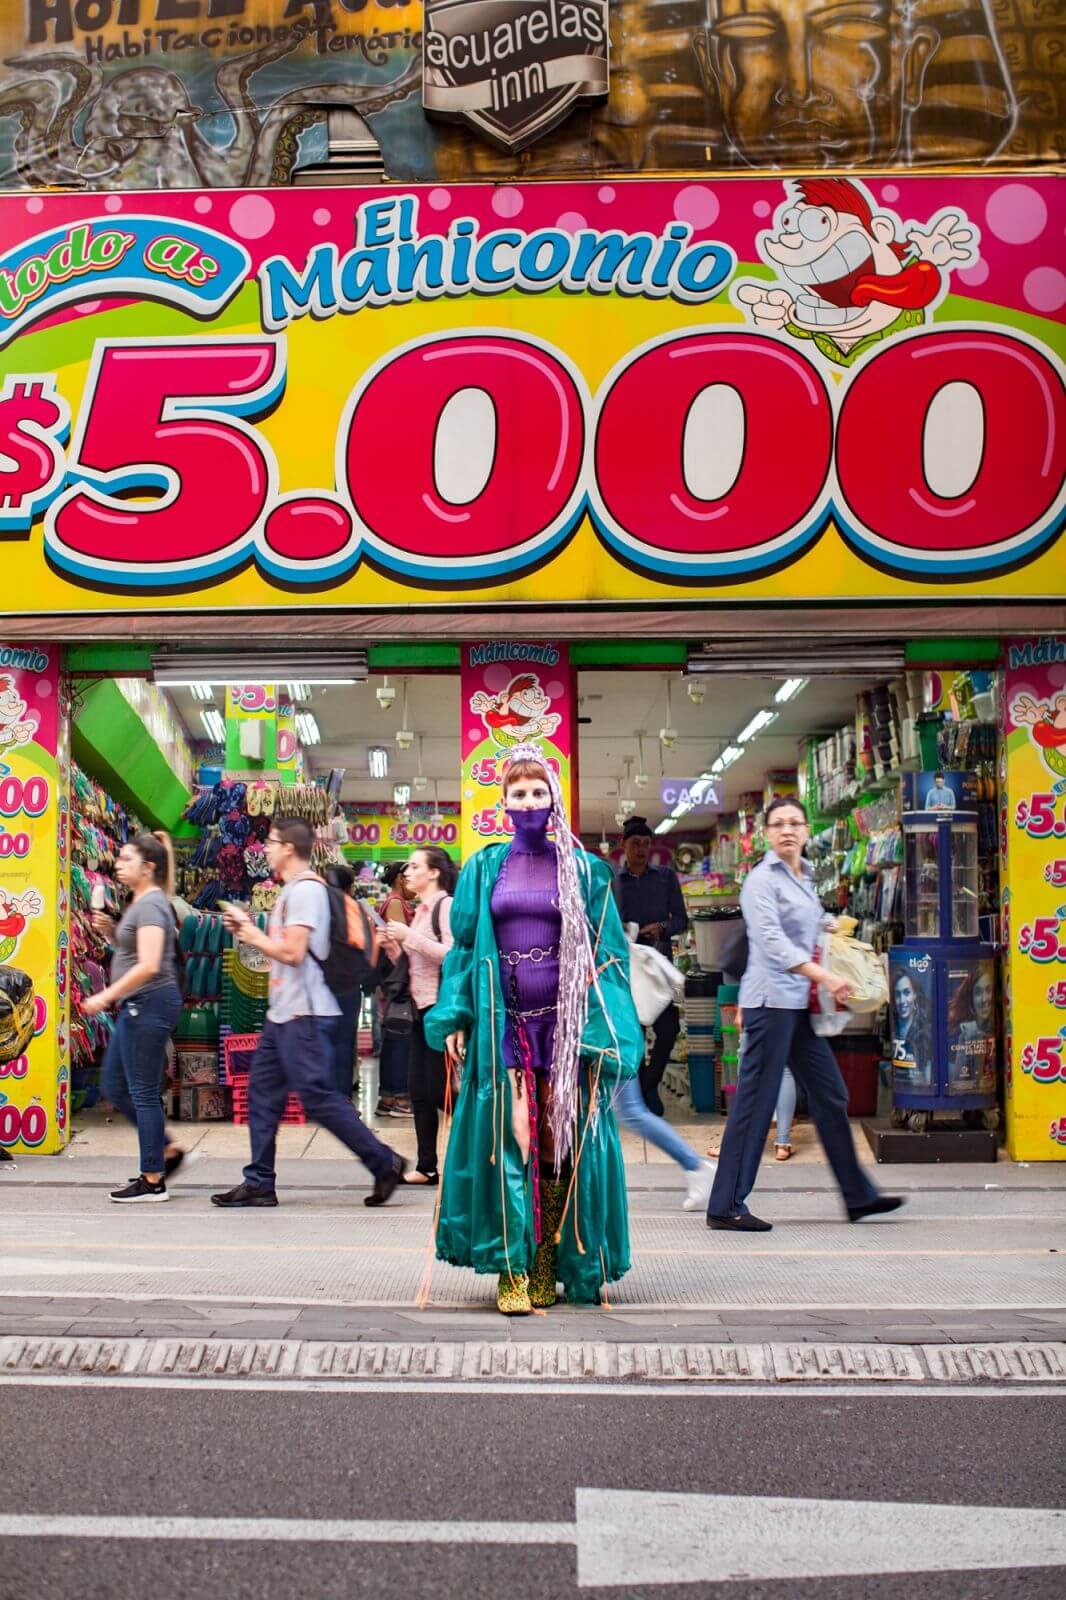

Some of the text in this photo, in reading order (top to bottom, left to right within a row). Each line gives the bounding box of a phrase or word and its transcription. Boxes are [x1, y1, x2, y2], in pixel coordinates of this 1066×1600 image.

[426, 3, 603, 69] acuarelas
[490, 61, 545, 111] inn
[358, 195, 418, 249] El
[0, 222, 136, 318] todo
[260, 219, 736, 332] Manicomio
[662, 788, 719, 805] CAJA
